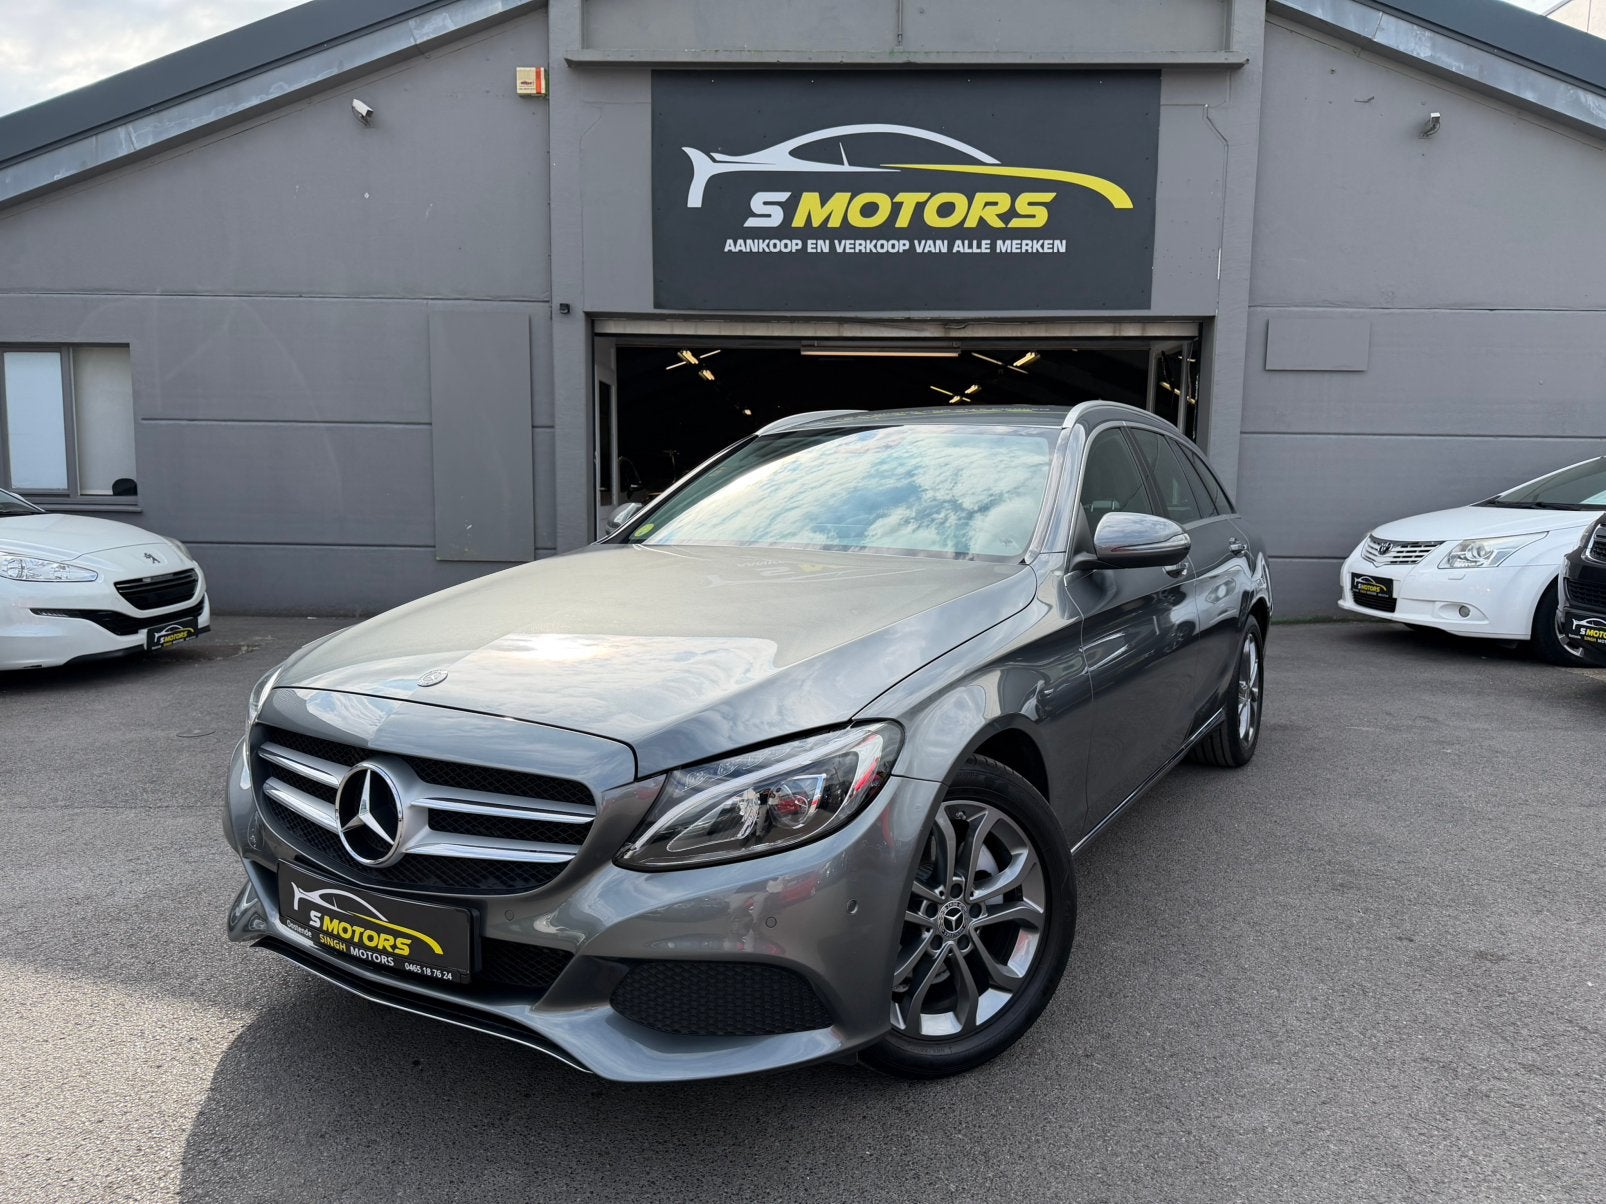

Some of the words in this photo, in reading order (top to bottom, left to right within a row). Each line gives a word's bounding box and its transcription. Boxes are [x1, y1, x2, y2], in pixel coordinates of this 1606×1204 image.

[743, 191, 792, 228] S
[791, 191, 1057, 228] MOTORS
[724, 239, 803, 253] AANKOOP
[807, 239, 830, 253] EN
[834, 239, 910, 253] VERKOOP
[914, 239, 949, 253] VAN
[952, 239, 992, 253] ALLE
[996, 239, 1066, 253] MERKEN
[1586, 629, 1606, 638] MOTO
[309, 910, 322, 928] S
[322, 915, 412, 956] MOTORS
[320, 934, 347, 952] SINGH
[350, 946, 395, 966] MOTORS
[404, 962, 422, 973] 0465
[423, 966, 432, 976] 18
[433, 969, 442, 978] 76
[443, 971, 452, 980] 24
